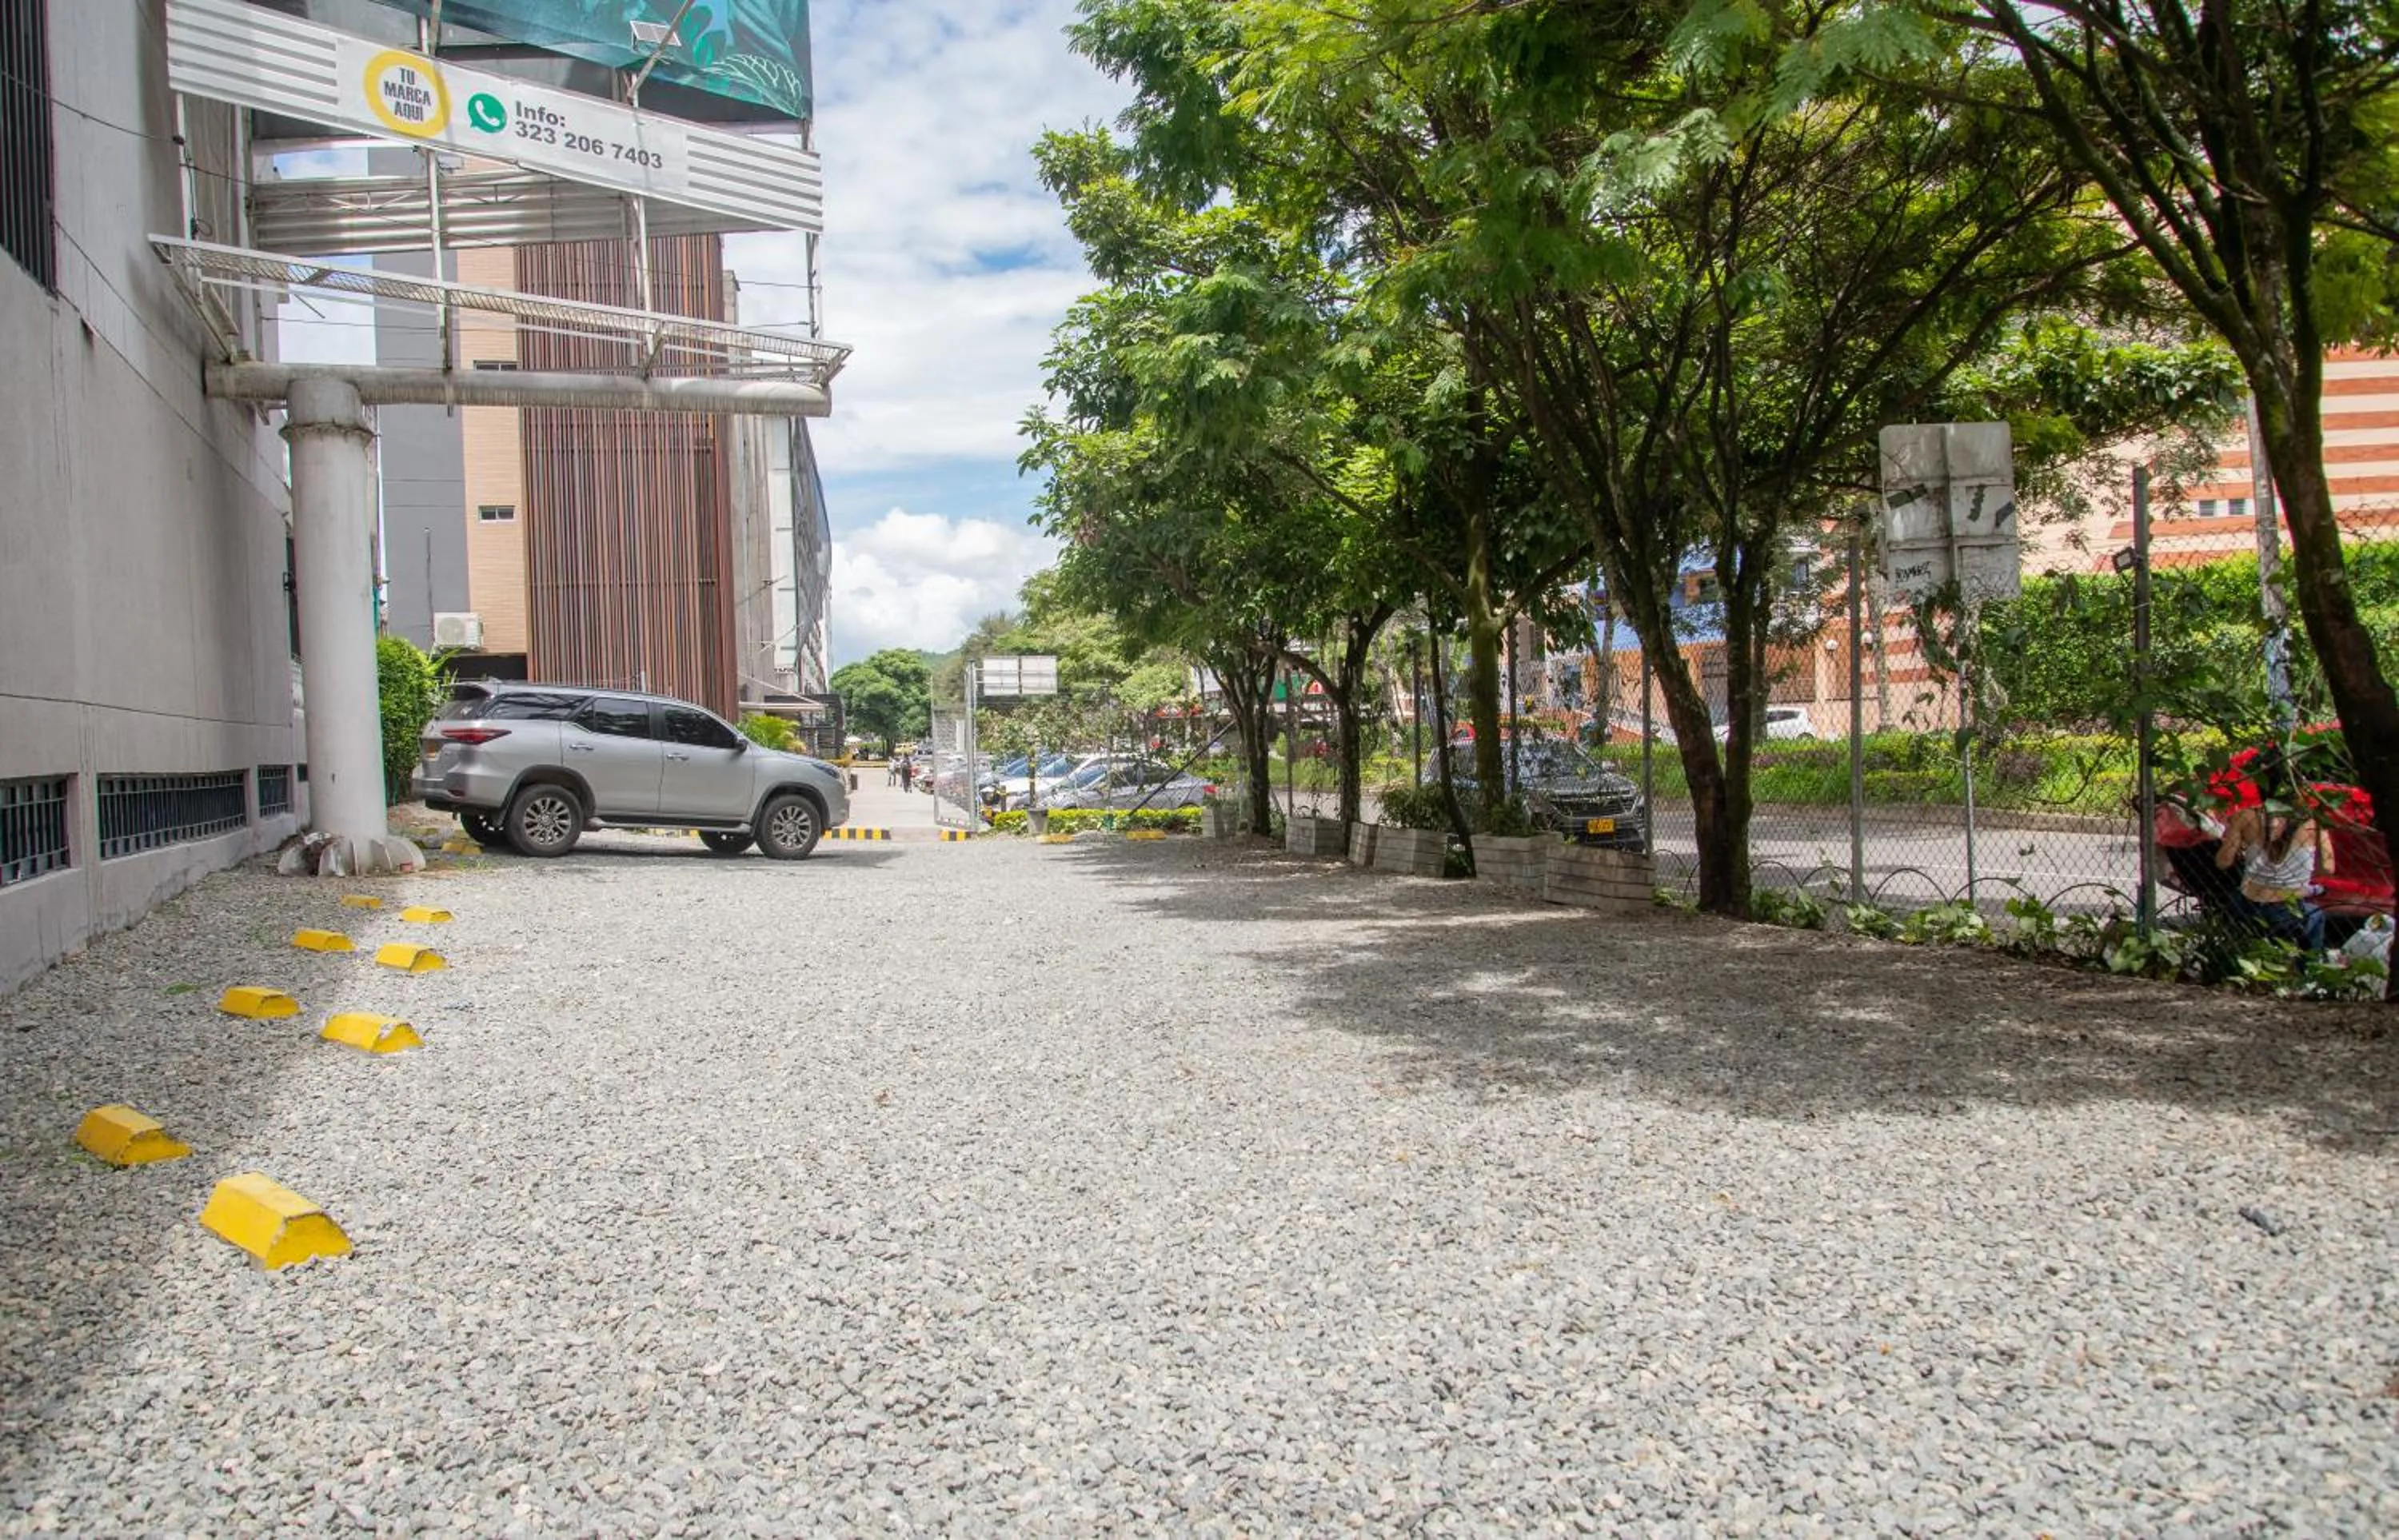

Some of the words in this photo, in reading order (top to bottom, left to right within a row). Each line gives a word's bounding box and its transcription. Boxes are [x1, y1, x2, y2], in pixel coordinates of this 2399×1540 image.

[399, 68, 415, 85] TU
[384, 81, 430, 106] MARCA
[516, 101, 565, 127] Info:
[515, 121, 557, 144] 323
[564, 132, 604, 155] 206
[611, 144, 662, 169] 7403
